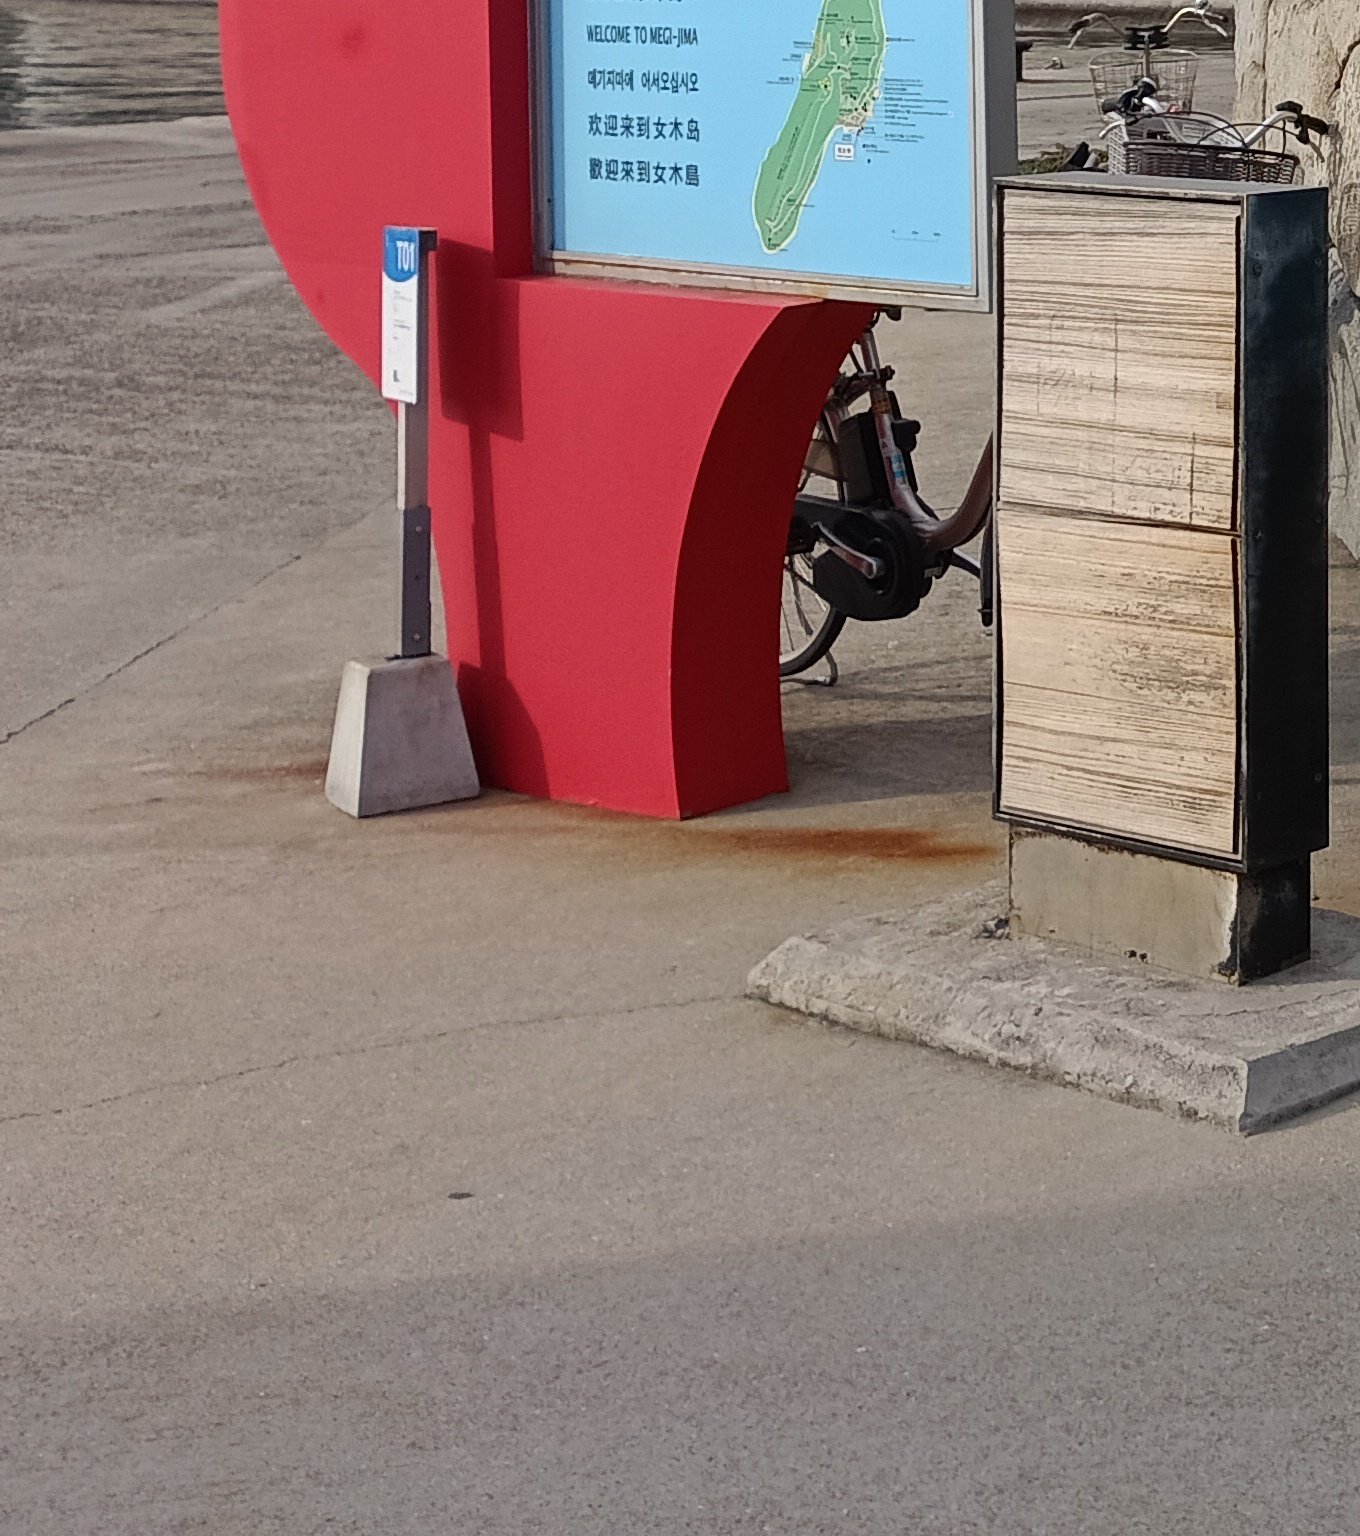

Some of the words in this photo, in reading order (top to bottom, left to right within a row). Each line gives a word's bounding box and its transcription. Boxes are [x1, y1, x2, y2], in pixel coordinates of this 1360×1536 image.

[587, 25, 630, 43] WELCOME
[634, 26, 647, 44] TO
[650, 27, 698, 48] MEGI-JIMA
[641, 69, 699, 94] 어서오십시오
[588, 112, 700, 142] 欢迎来到女木岛
[396, 240, 415, 272] T01
